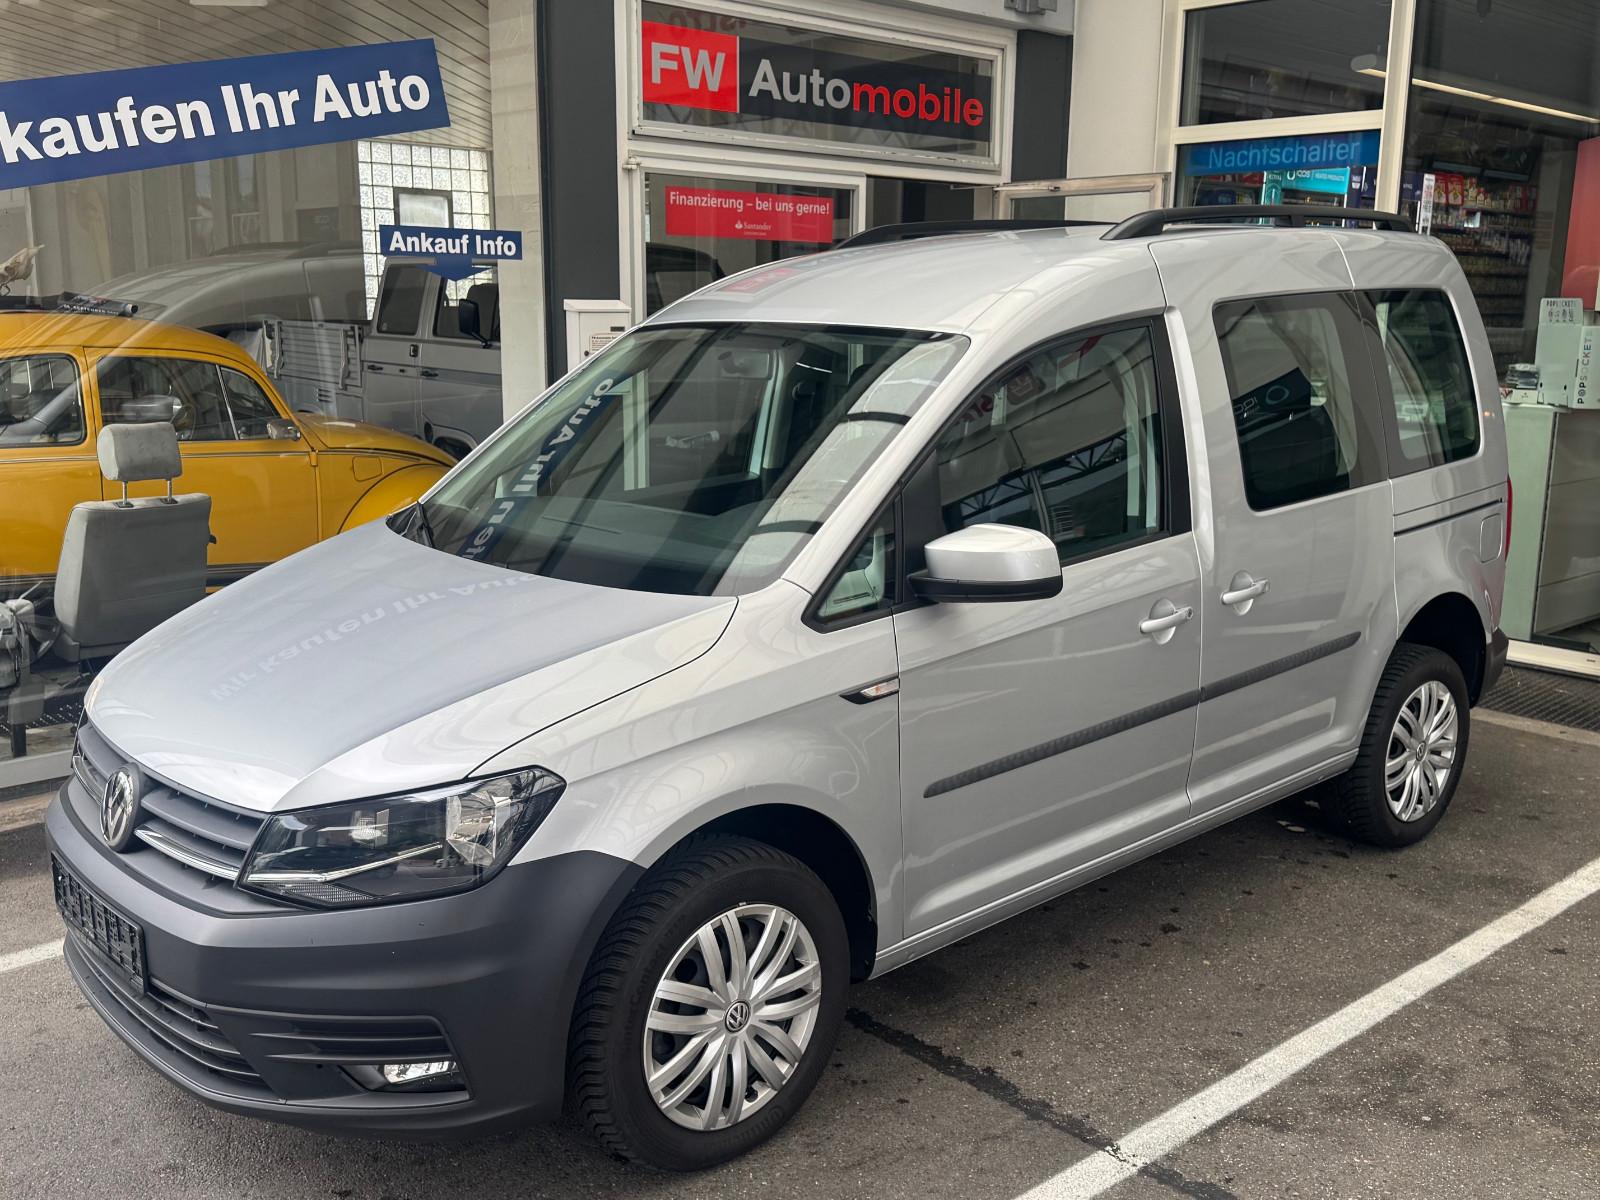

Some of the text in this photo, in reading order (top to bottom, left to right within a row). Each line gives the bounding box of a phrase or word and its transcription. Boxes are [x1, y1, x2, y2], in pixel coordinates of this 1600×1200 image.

[651, 42, 984, 127] FW Automobile
[0, 69, 431, 164] kaufen Ihr Auto
[1209, 138, 1361, 169] Nachtschalter
[669, 191, 744, 213] Finanzierung
[755, 197, 772, 211] bei
[775, 203, 794, 213] uns
[795, 203, 830, 216] gerne!
[389, 231, 517, 256] Ankauf Info
